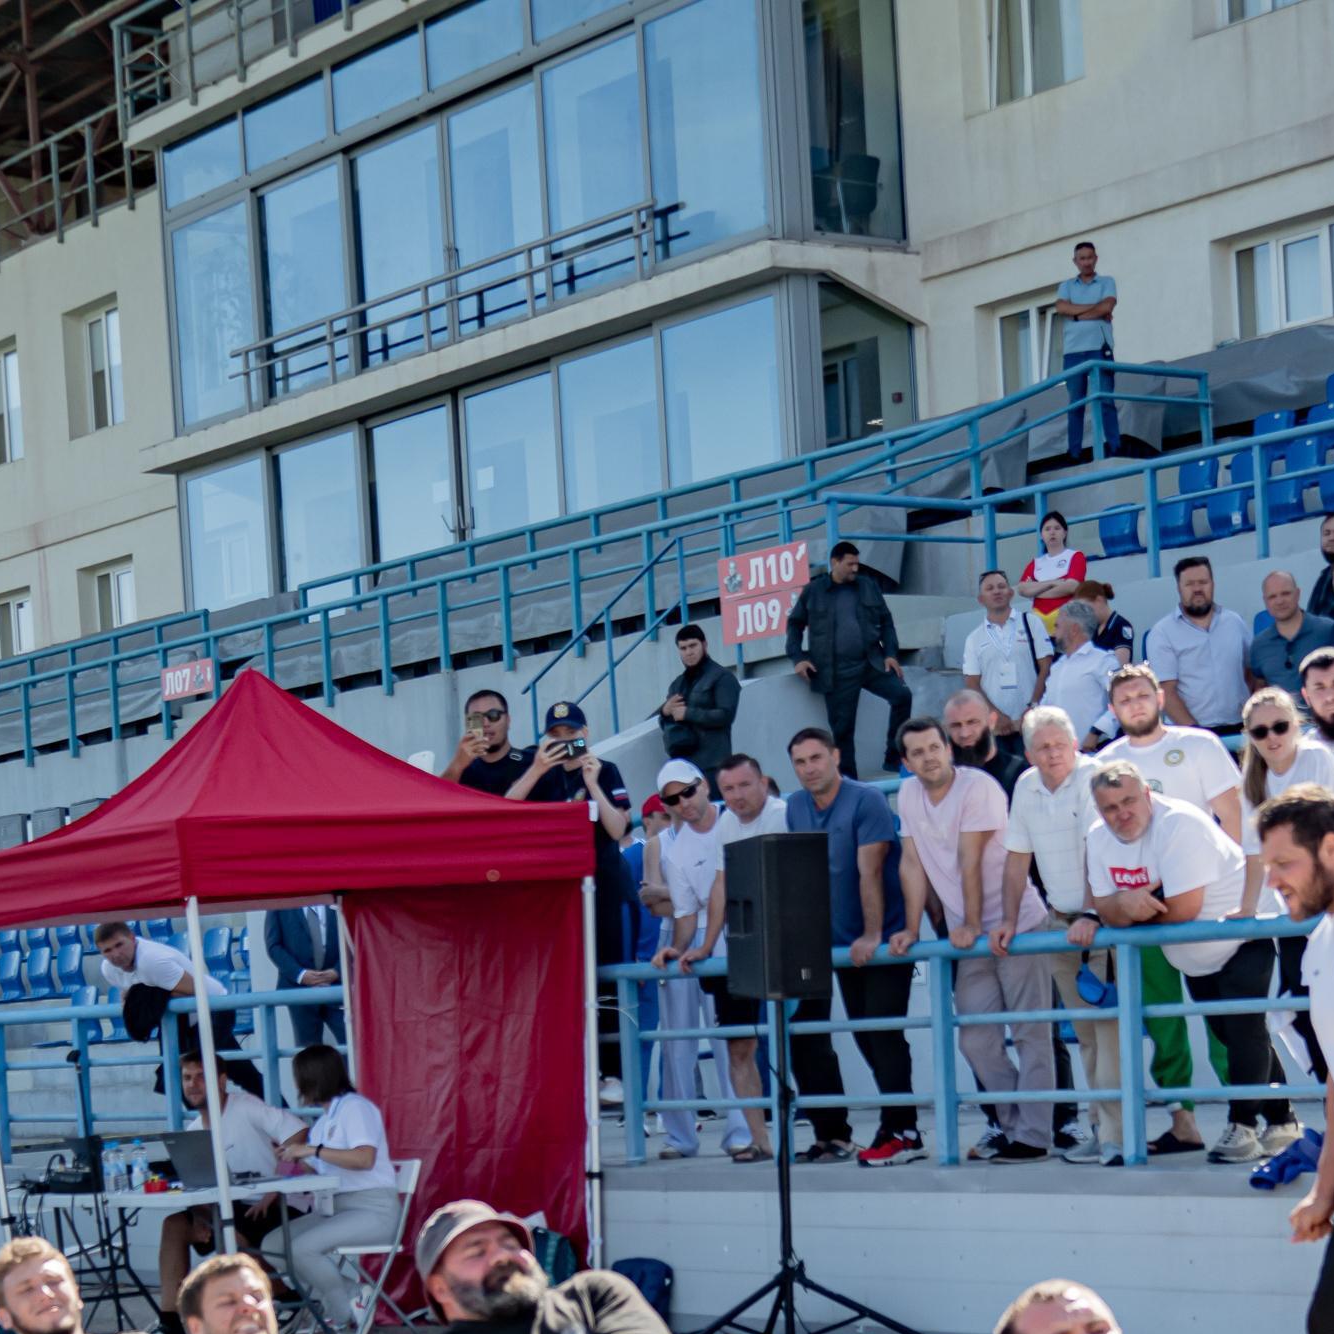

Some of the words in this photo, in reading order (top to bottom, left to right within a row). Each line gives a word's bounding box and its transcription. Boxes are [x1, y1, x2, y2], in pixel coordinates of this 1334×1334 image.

[748, 550, 794, 590] Л10
[736, 598, 781, 637] Л09
[164, 668, 191, 696] Л07
